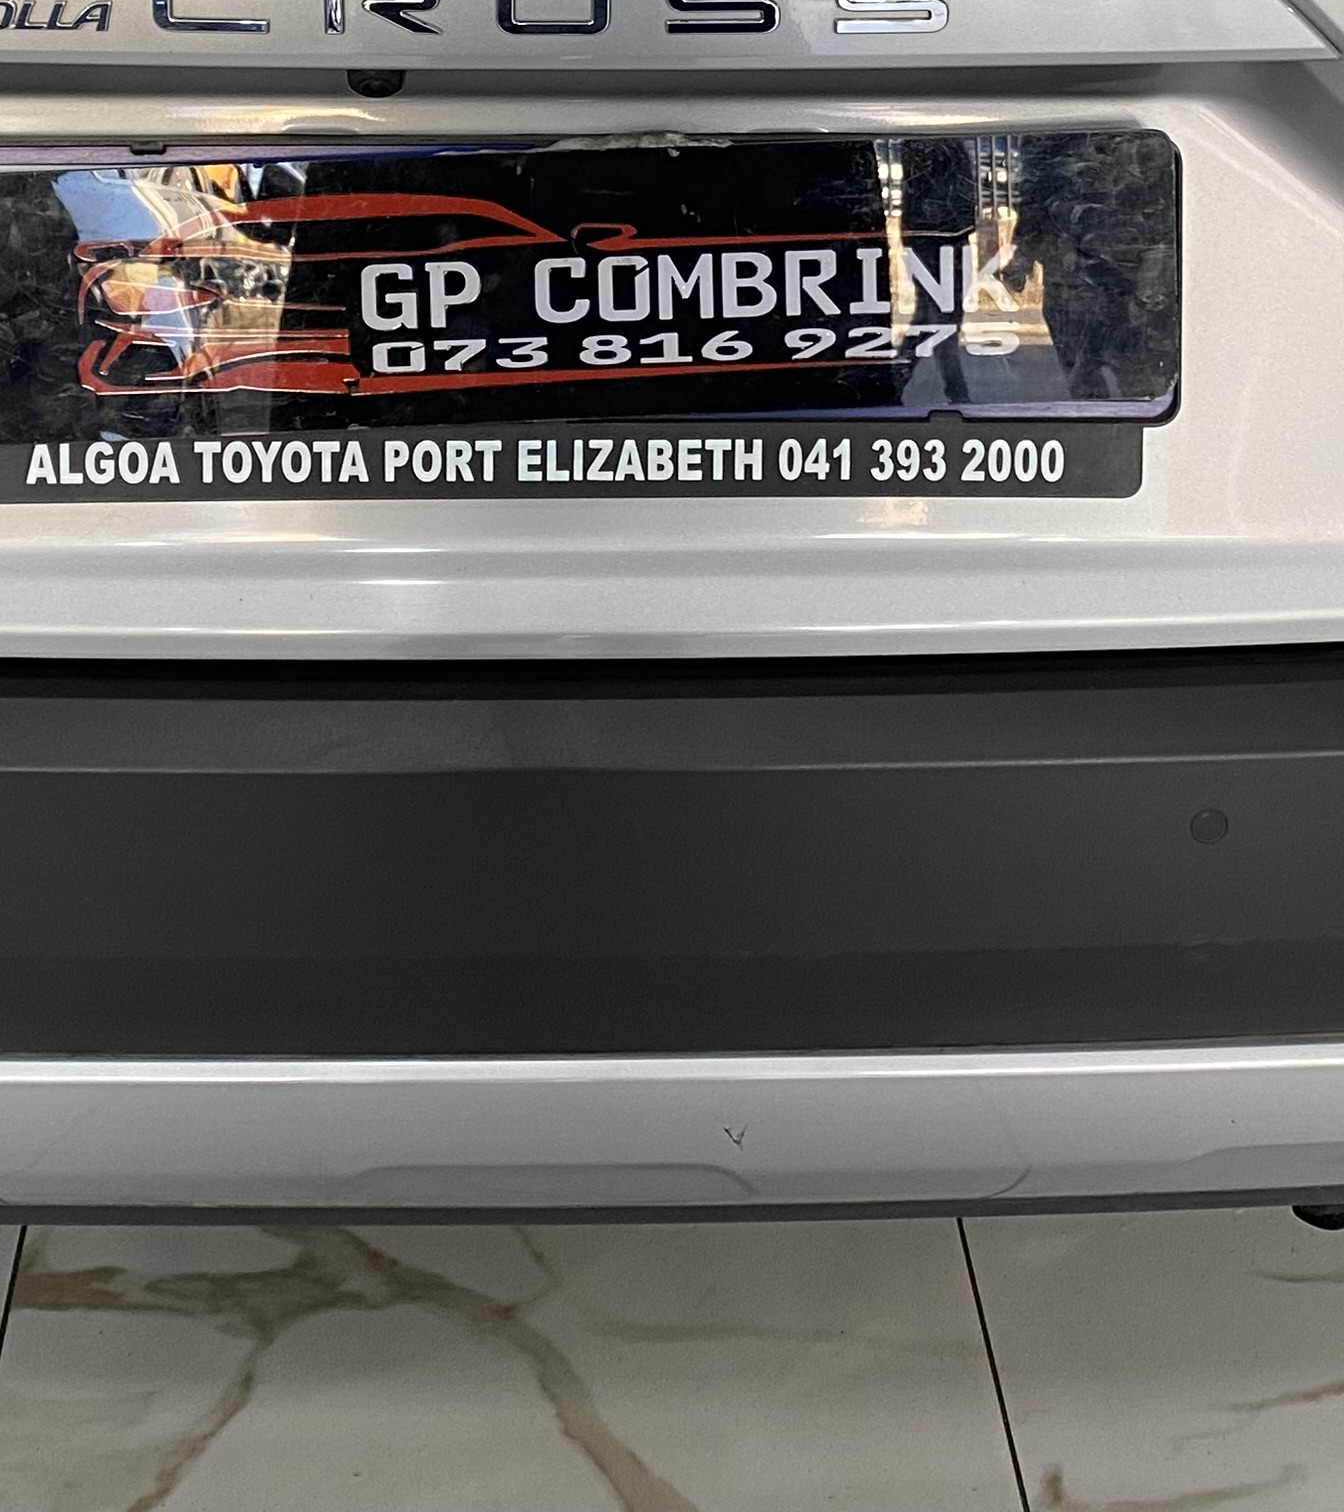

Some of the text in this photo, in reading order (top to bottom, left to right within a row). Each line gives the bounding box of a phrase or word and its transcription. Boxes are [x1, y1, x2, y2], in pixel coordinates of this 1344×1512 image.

[360, 244, 1020, 331] GP COMBRINK
[371, 321, 1021, 373] 073 816 9275
[25, 438, 1066, 485] ALGOA TOYOTA PORT ELIZABETH 041 393 2000
